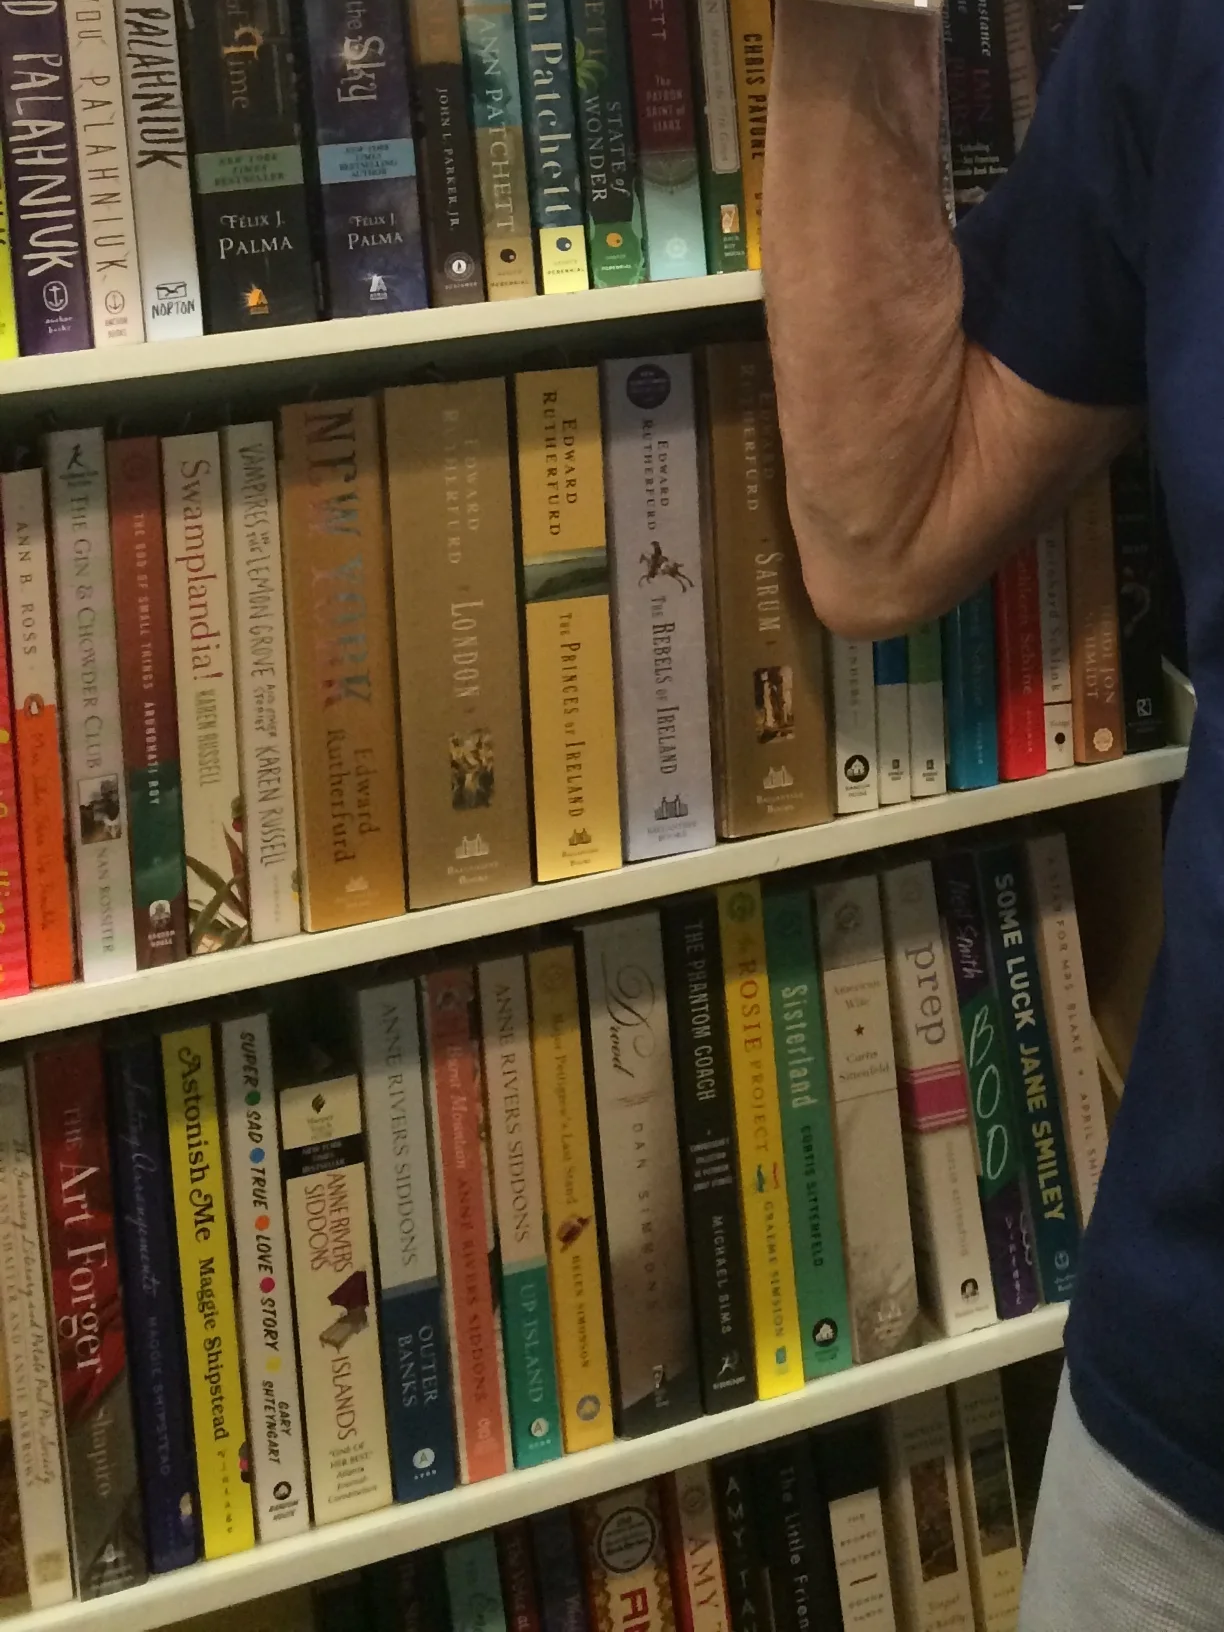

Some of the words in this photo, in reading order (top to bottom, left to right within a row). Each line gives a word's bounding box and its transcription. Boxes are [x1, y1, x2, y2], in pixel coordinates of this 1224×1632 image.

[475, 18, 502, 79] ANN
[743, 32, 765, 88] CHRIS
[124, 6, 188, 170] PALAHNIUK
[9, 51, 80, 278] PALAHNIUK
[484, 88, 516, 232] PATCHETT
[530, 41, 573, 218] Patchett
[584, 94, 608, 203] WONDER
[746, 94, 767, 161] PAVONE
[79, 74, 128, 274] PALAHNIUK
[219, 236, 293, 260] PALMA
[347, 233, 403, 250] PALMA
[151, 300, 196, 317] NORTON
[542, 390, 563, 537] RUTHERFURD
[562, 418, 578, 506] EDWARD
[641, 419, 657, 532] RUTHERFURD
[657, 439, 671, 508] EDWARD
[174, 457, 224, 683] Swamplandia!
[753, 550, 785, 633] SARUM
[450, 597, 486, 700] LONDON
[558, 611, 573, 638] THE
[561, 639, 582, 715] PRINCES
[565, 723, 576, 736] OF
[255, 742, 282, 800] KAREN
[565, 740, 586, 818] IRELAND
[259, 802, 286, 868] RUSSELL
[683, 922, 701, 965] THE
[995, 872, 1023, 950] SOME
[493, 982, 511, 1045] ANNE
[687, 966, 710, 1043] PHANTOM
[738, 960, 764, 1053] ROSIE
[904, 941, 946, 1047] prep
[1006, 955, 1036, 1031] LUCK
[239, 1032, 257, 1087] SUPER
[384, 1006, 401, 1066] ANNE
[693, 1044, 717, 1101] COACH
[781, 982, 817, 1110] Sisterland
[177, 1046, 207, 1186] Astonish
[387, 1073, 408, 1158] RIVERS
[499, 1047, 522, 1127] RIVERS
[749, 1058, 770, 1153] PROJECT
[1018, 1044, 1047, 1114] JANE
[246, 1110, 263, 1145] SAD
[249, 1166, 269, 1210] TRUE
[506, 1130, 528, 1243] SIDDONS
[1031, 1120, 1066, 1222] SMILEY
[188, 1188, 212, 1243] Me
[303, 1184, 329, 1272] SIDDONS
[394, 1161, 417, 1267] SIDDONS
[254, 1233, 274, 1276] LOVE
[198, 1256, 218, 1331] Maggie
[259, 1297, 280, 1352] STORY
[519, 1283, 536, 1318] UP
[203, 1333, 231, 1441] Shipstead
[330, 1353, 358, 1442] ISLANDS
[398, 1333, 418, 1407] BANKS
[417, 1325, 438, 1404] OUTER
[521, 1320, 545, 1404] ISLAND
[277, 1400, 291, 1437] GARY
[686, 1536, 720, 1610] AMY
